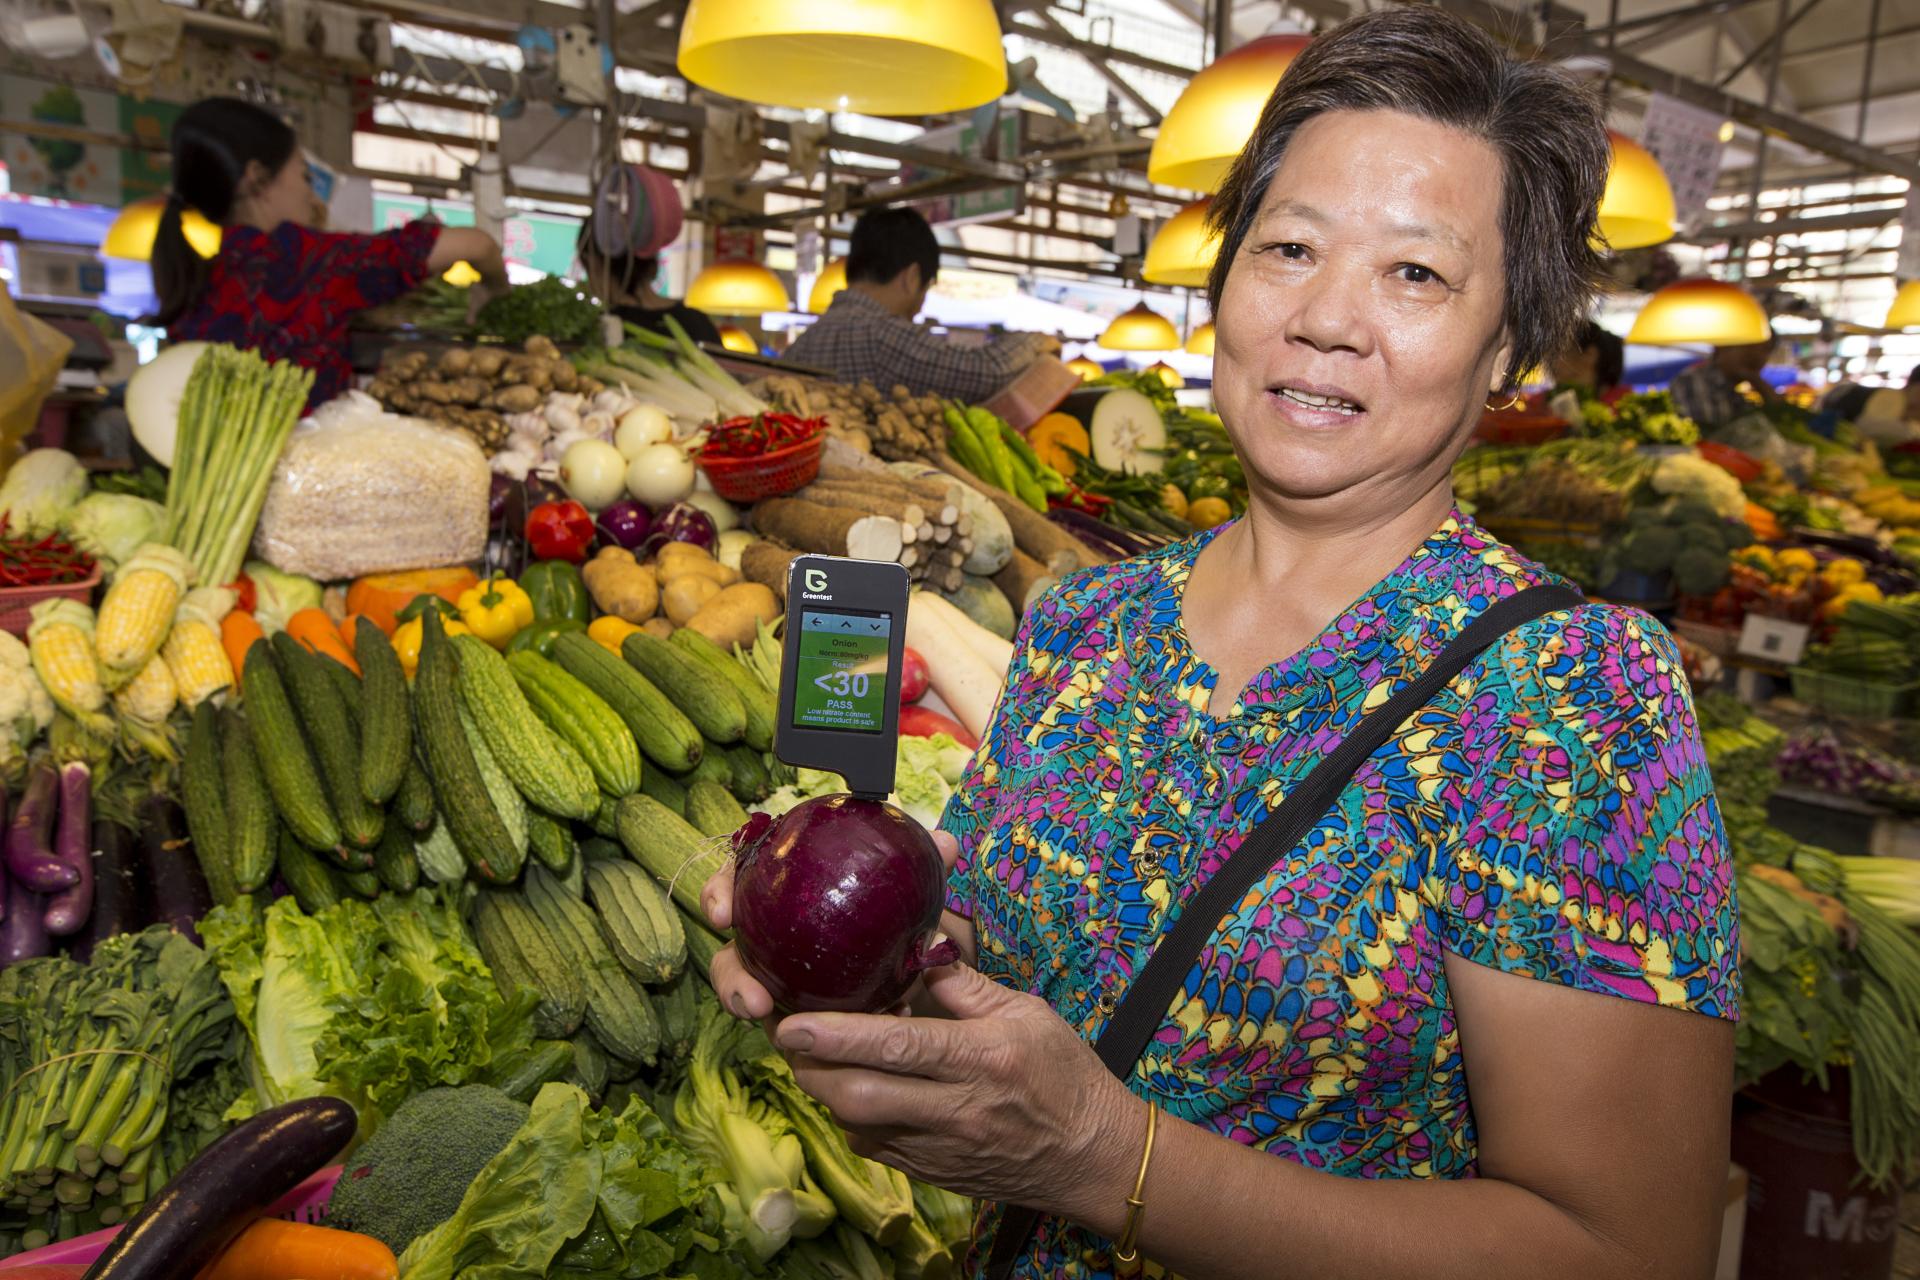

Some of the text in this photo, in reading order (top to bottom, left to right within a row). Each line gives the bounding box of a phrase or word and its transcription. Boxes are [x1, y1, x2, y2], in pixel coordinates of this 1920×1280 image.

[802, 592, 833, 600] Greentest
[832, 639, 858, 648] Onion
[832, 660, 855, 669] Result
[814, 671, 869, 697] <30
[827, 699, 853, 709] PASS
[845, 711, 871, 719] content
[826, 717, 852, 725] product
